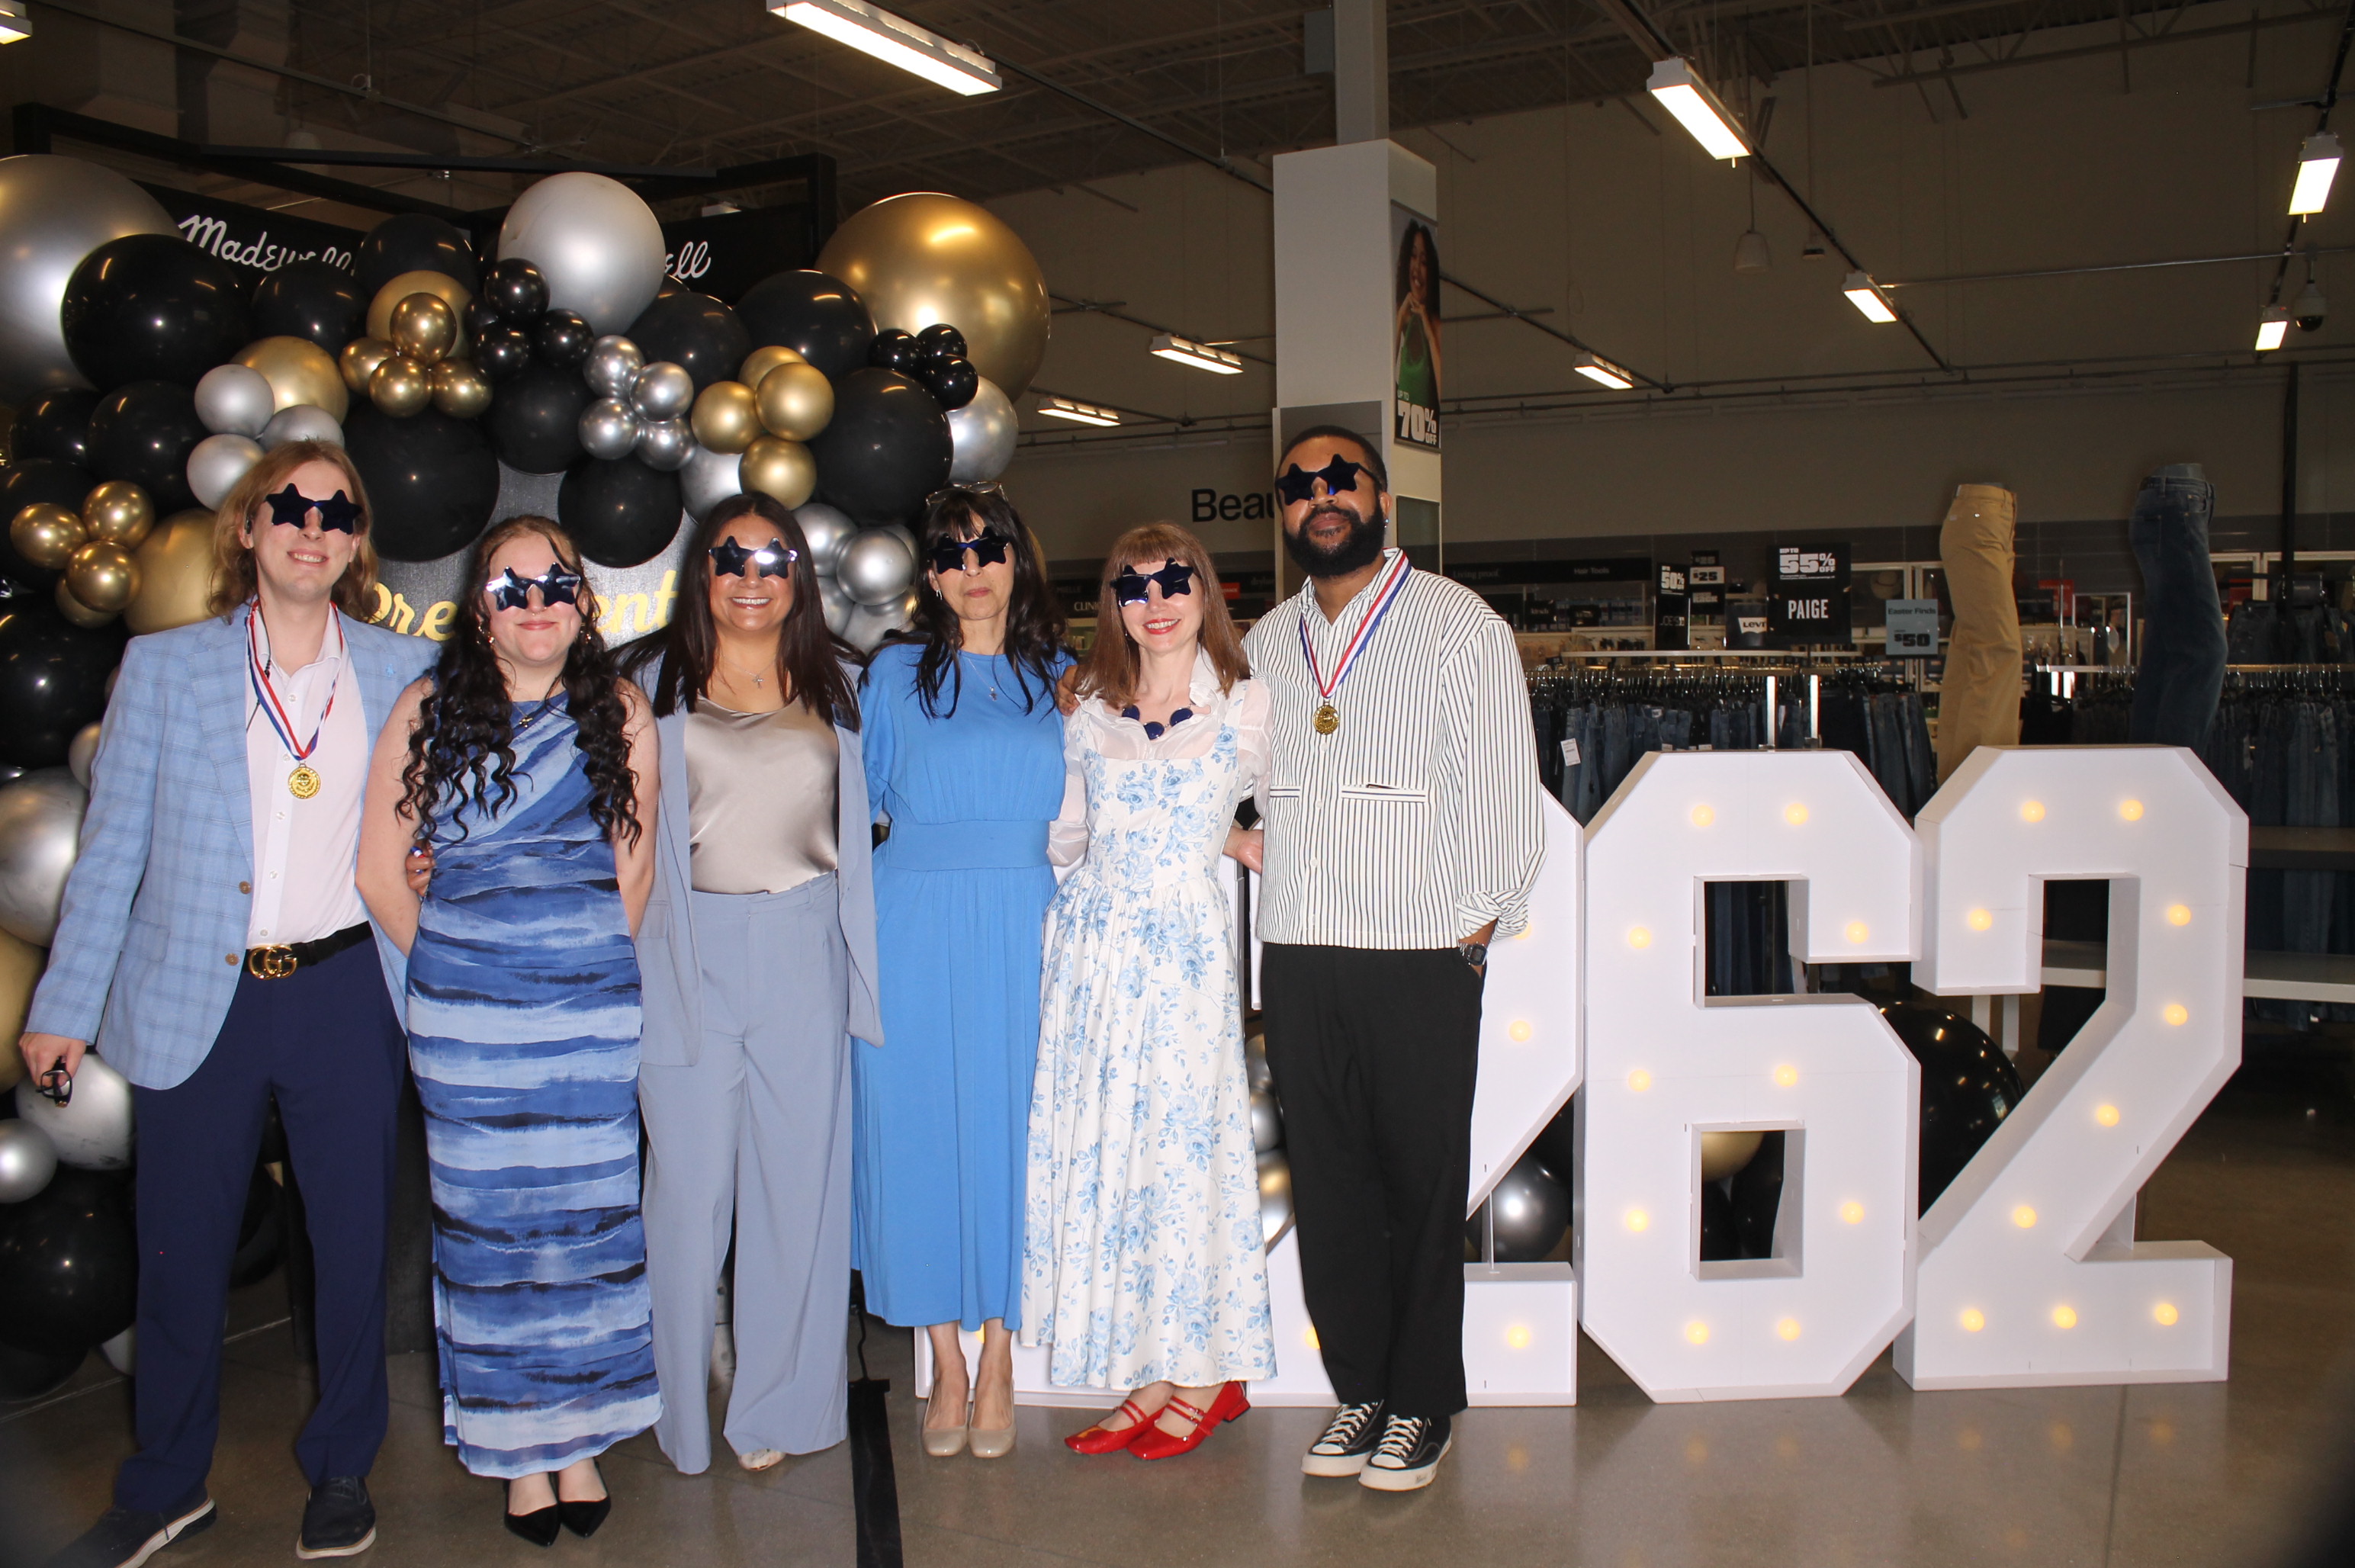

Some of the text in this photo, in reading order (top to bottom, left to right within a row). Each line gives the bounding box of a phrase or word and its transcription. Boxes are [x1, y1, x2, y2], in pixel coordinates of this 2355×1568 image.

[1397, 399, 1437, 442] 70%
[1779, 553, 1836, 574] 55%
[1788, 599, 1829, 619] PAIGE
[1914, 606, 1936, 615] Finds
[1894, 633, 1930, 647] $50
